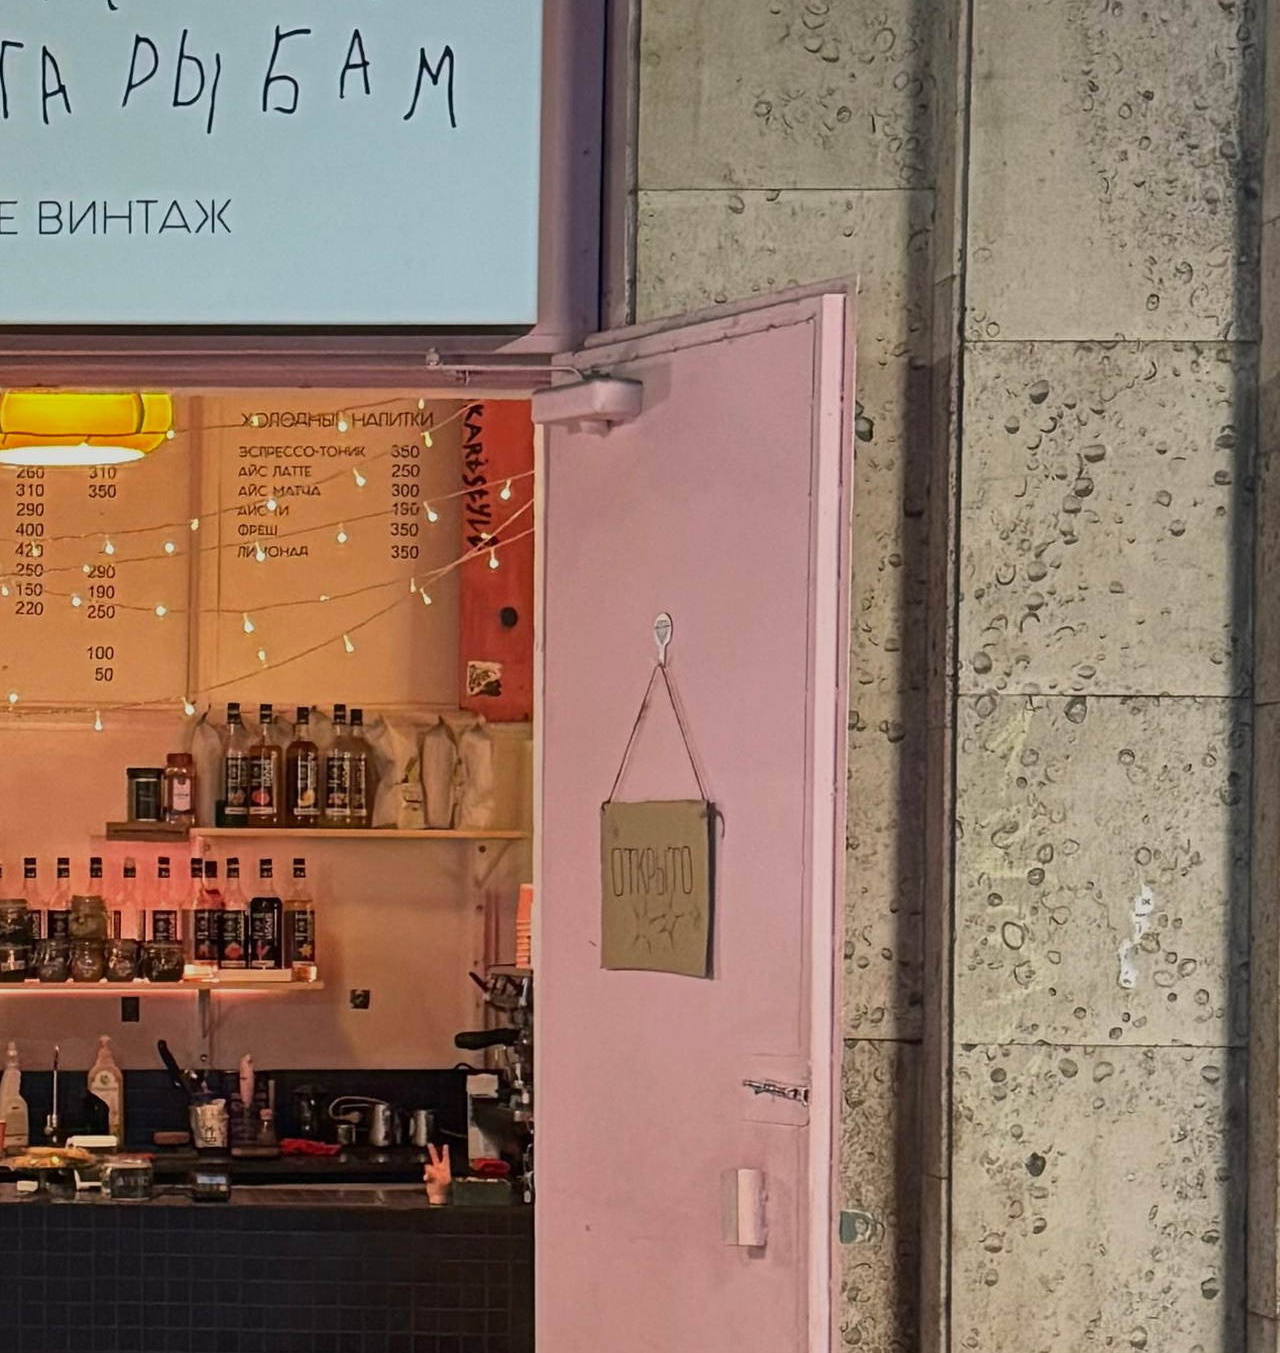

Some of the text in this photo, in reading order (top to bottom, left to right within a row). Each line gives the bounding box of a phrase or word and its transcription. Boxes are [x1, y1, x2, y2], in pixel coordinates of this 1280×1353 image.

[122, 23, 458, 133] РЫБАМ
[38, 198, 233, 235] ВИНТАЖ
[241, 411, 434, 428] ХОЛОДНЫ НАПИТКИ
[272, 465, 312, 478] ЛАТТЕ
[391, 464, 421, 478] 250
[15, 483, 45, 498] 310
[391, 484, 420, 498] 300
[15, 522, 45, 537] 400
[237, 523, 419, 537] ФРЕШ 350
[391, 545, 419, 559] 350
[15, 601, 44, 616] 220
[87, 646, 115, 660] 100
[94, 667, 114, 682] 50
[611, 845, 694, 897] ОТКРЫТО
